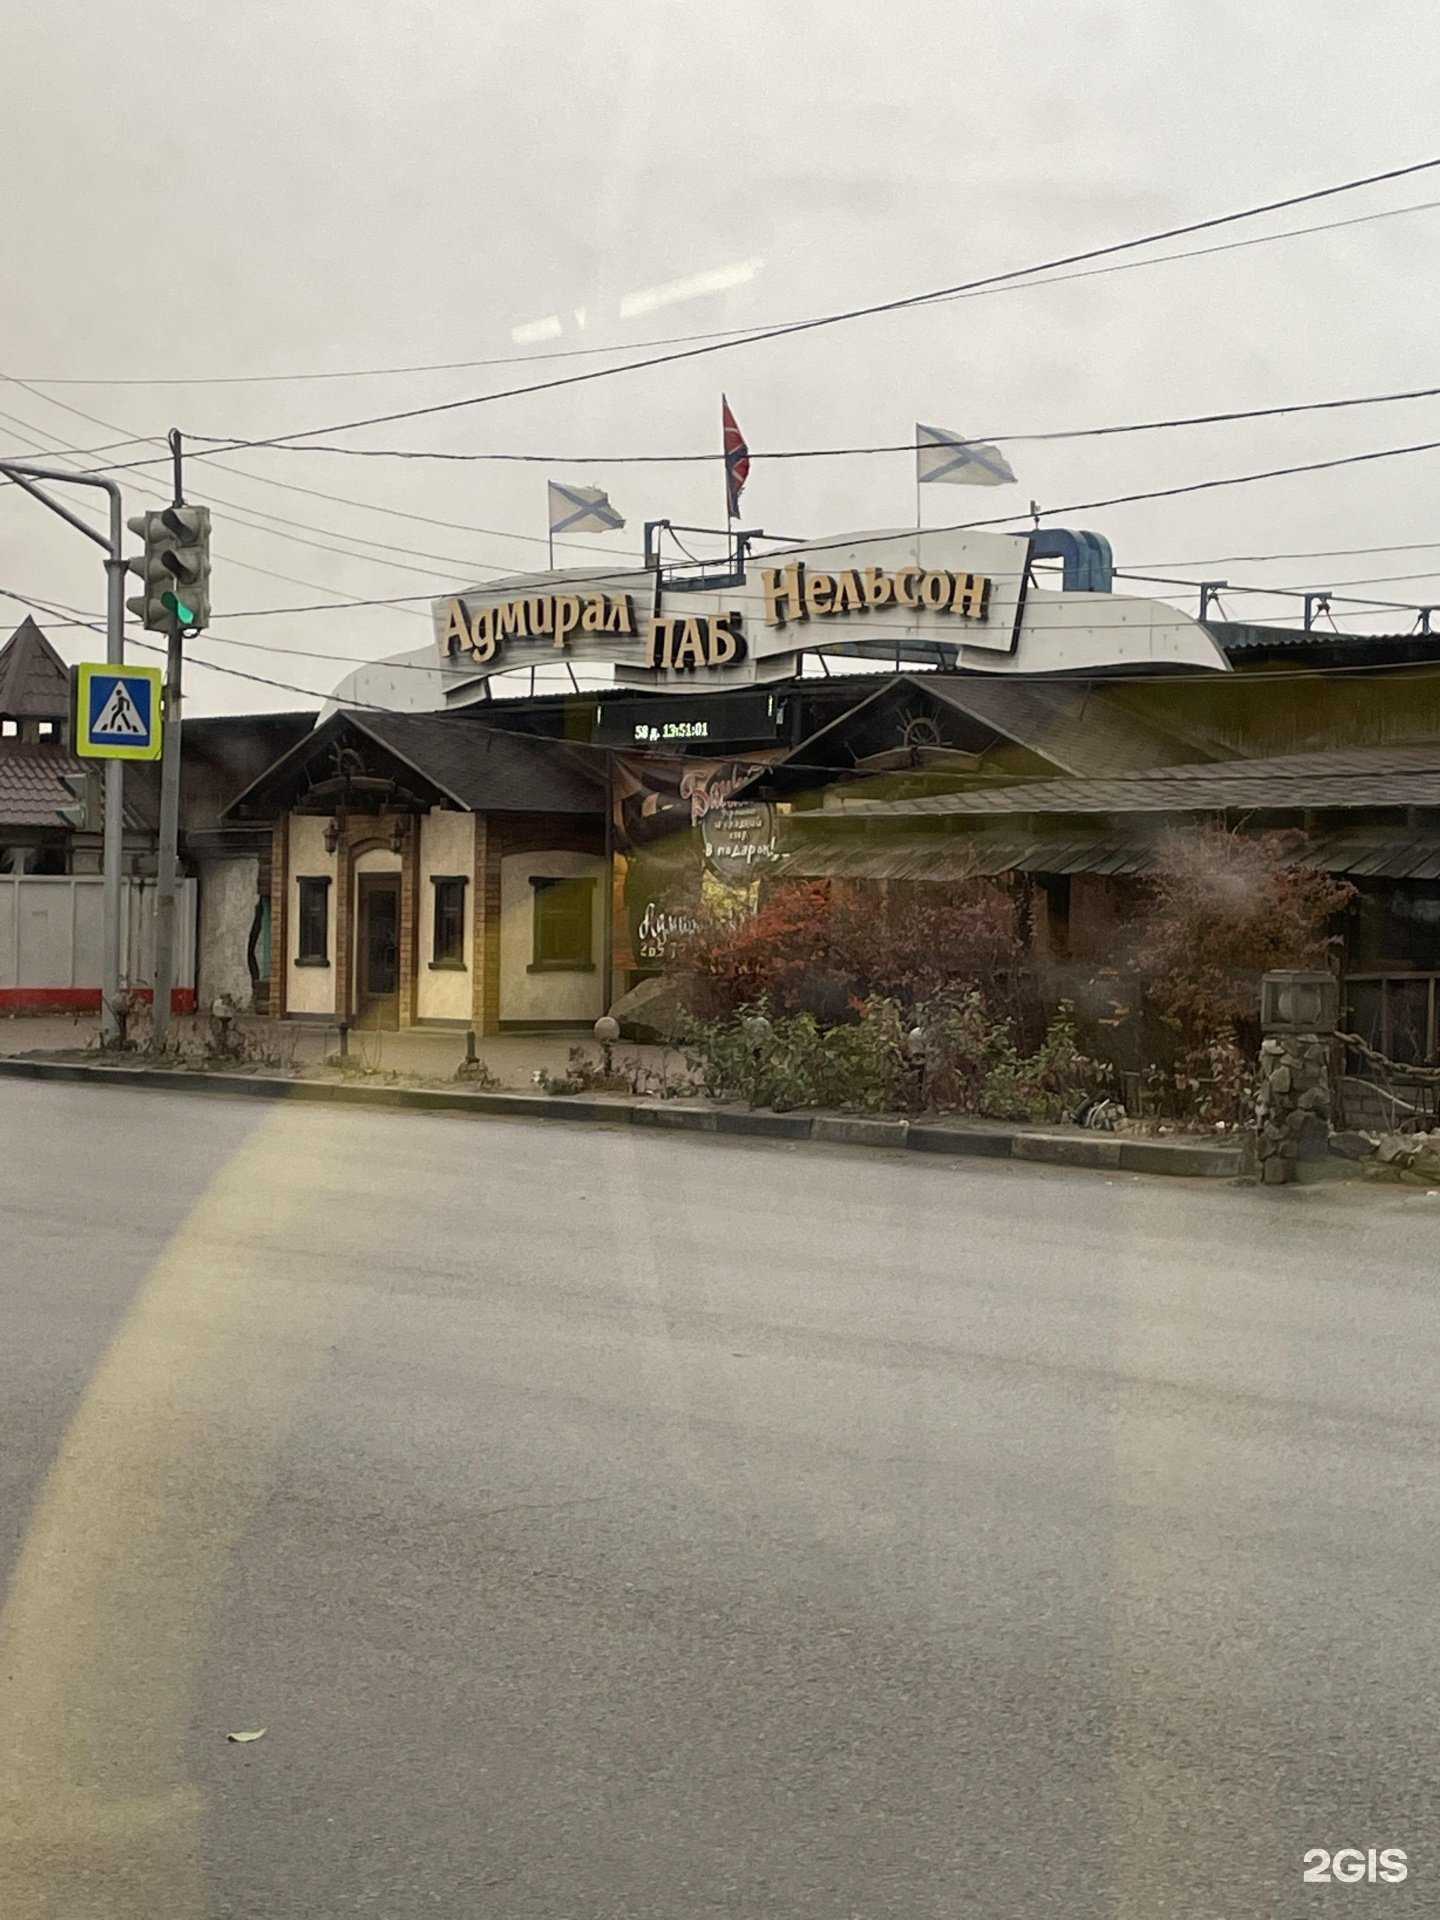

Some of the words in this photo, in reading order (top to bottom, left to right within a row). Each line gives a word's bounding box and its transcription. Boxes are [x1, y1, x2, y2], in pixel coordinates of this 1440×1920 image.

[440, 593, 633, 664] Адмирал
[762, 562, 988, 627] Нельсон
[646, 611, 742, 669] ПАБ
